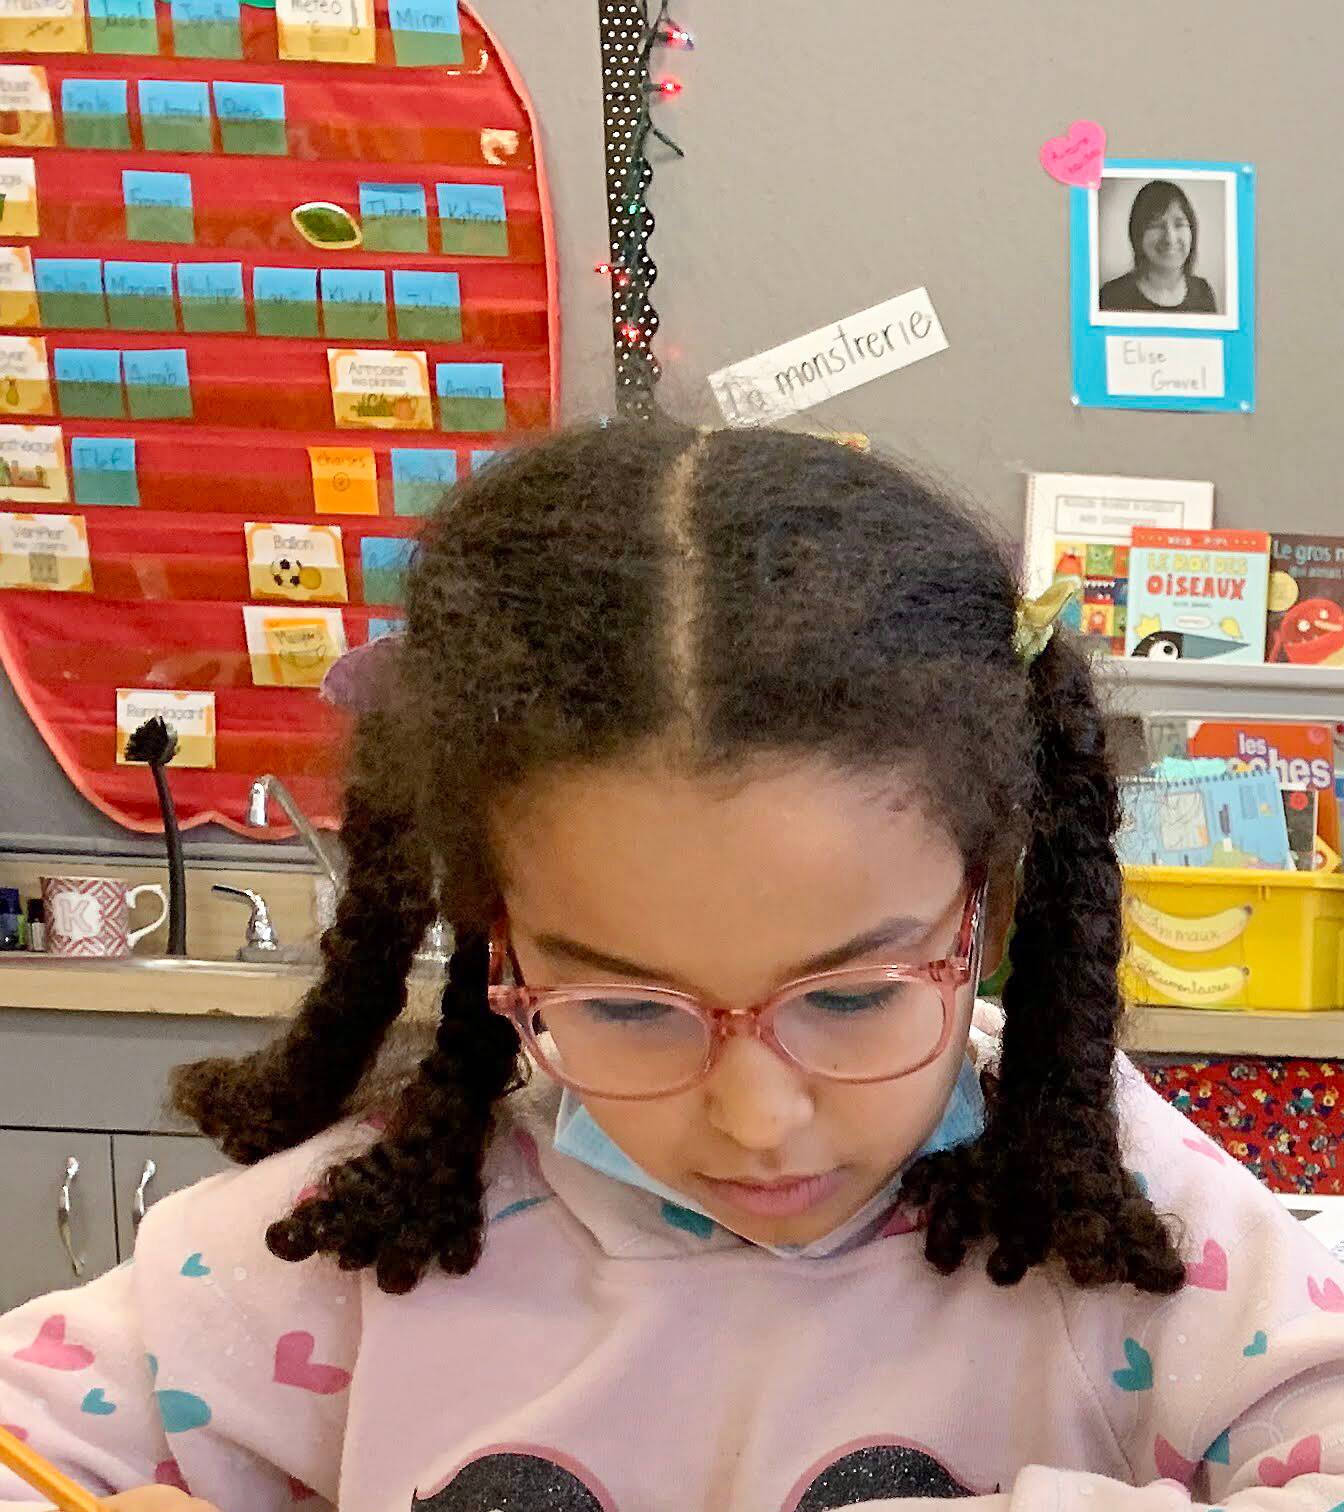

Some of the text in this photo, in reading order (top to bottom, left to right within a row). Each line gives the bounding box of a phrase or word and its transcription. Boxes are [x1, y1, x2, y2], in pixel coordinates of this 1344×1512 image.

[774, 309, 933, 396] monstrerie
[1150, 367, 1207, 393] Gravel
[1294, 544, 1332, 566] gros
[1237, 732, 1267, 755] les
[58, 898, 93, 933] K
